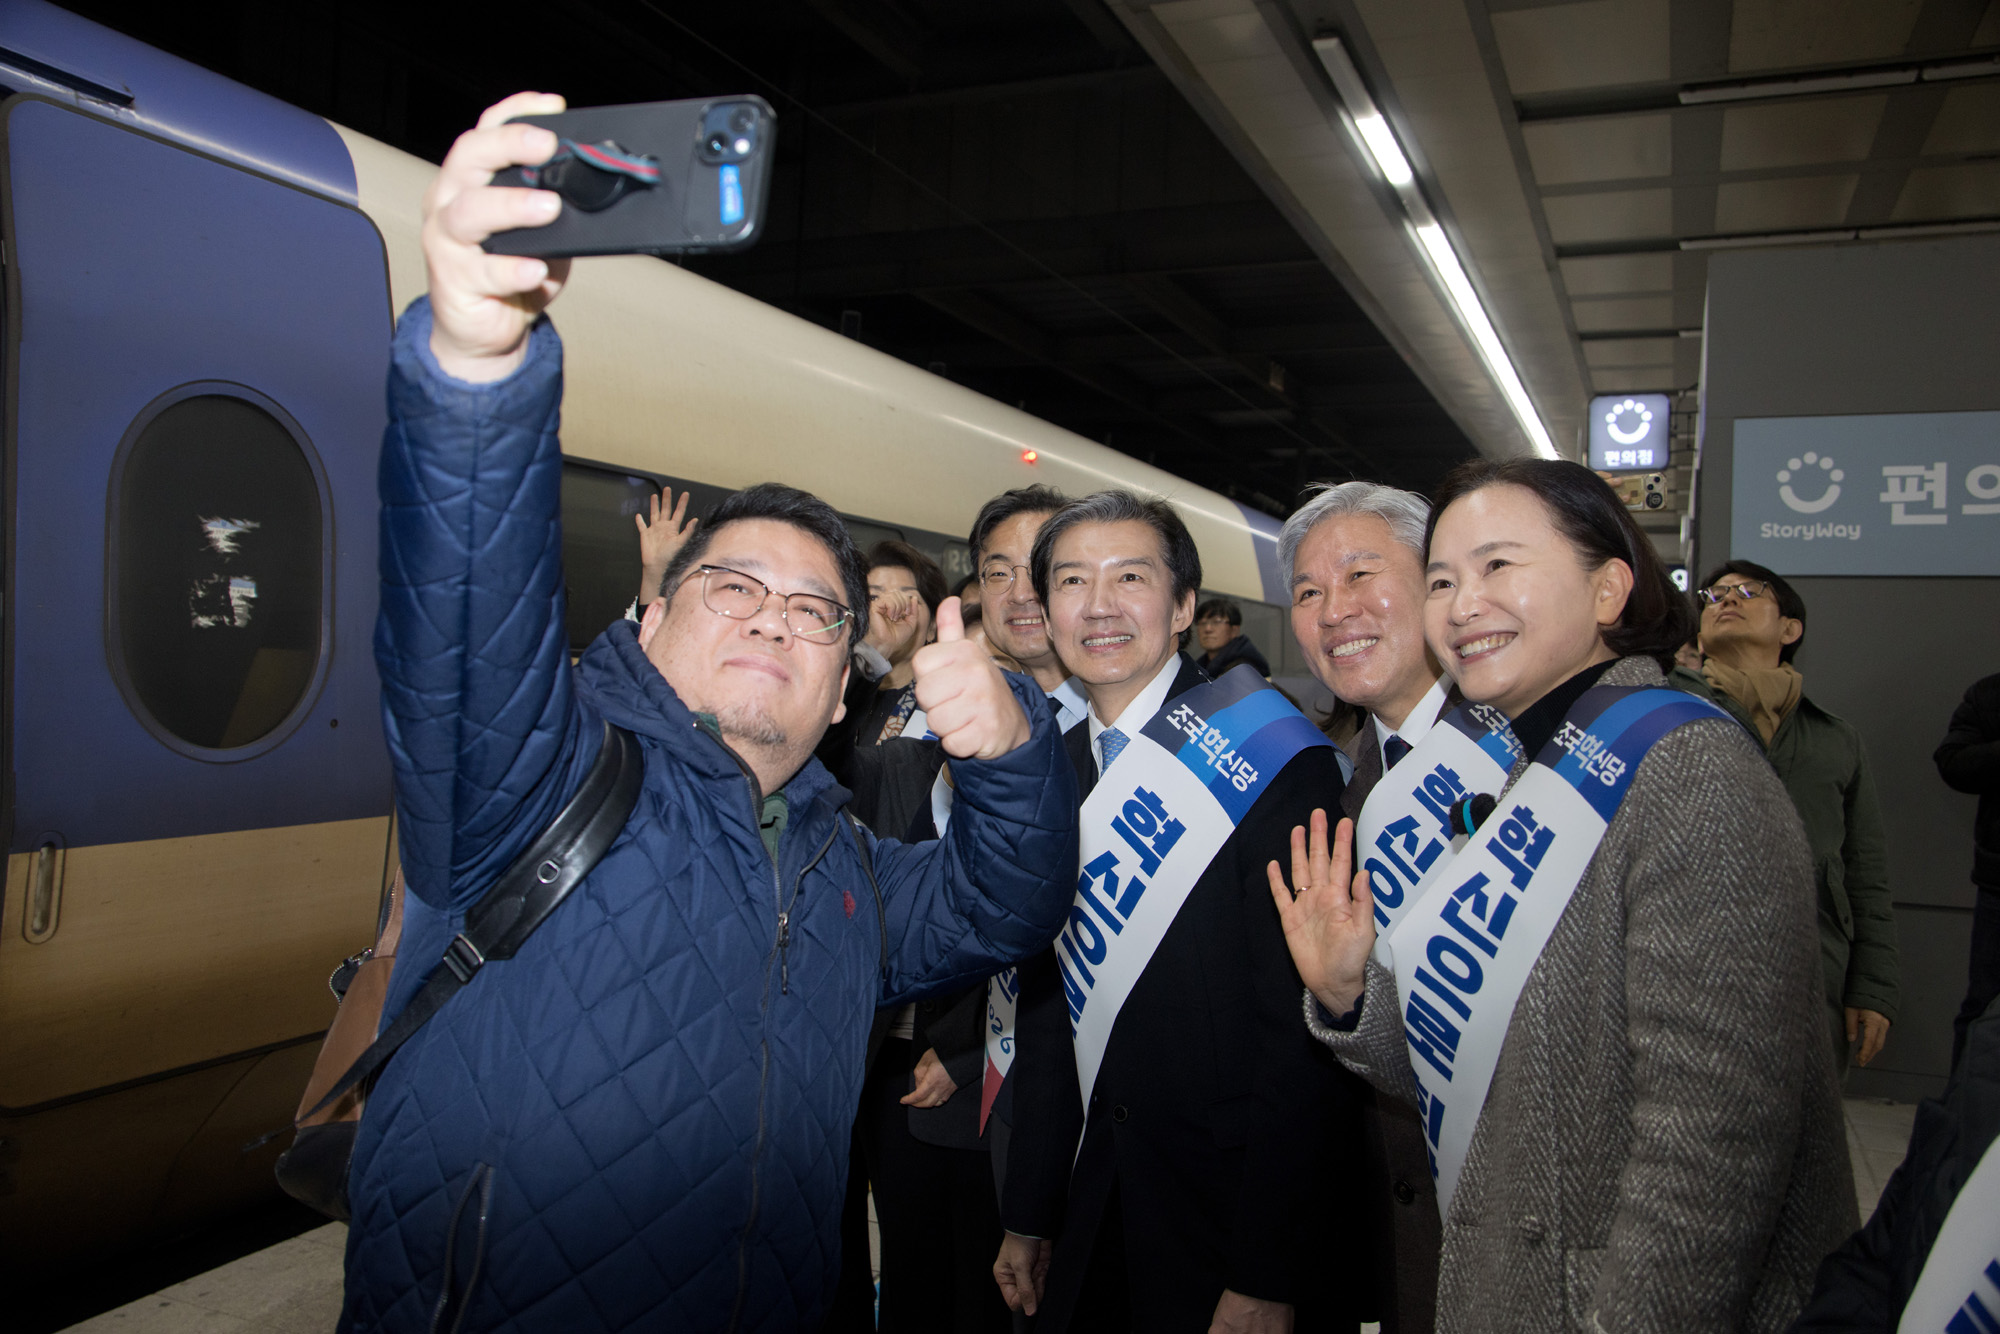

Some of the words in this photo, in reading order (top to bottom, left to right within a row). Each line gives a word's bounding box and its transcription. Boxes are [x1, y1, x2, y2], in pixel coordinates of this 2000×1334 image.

[1604, 449, 1654, 467] 편의점
[1760, 522, 1861, 541] StoryWay
[1166, 703, 1259, 792] 조국혁신당
[1468, 702, 1524, 757] 조국혁
[1552, 720, 1626, 787] 조국혁신당
[1364, 763, 1475, 938] 혁신으
